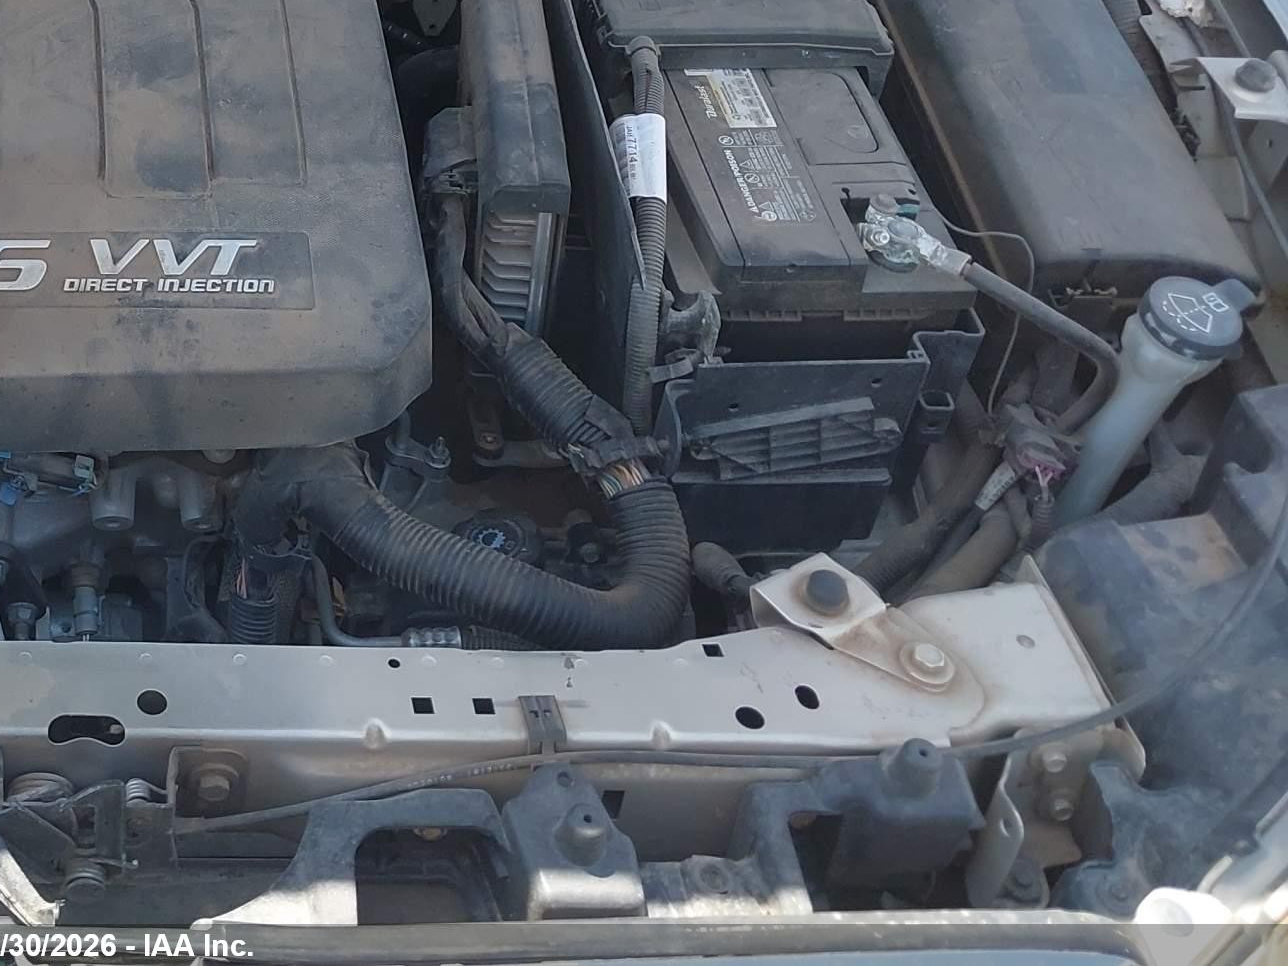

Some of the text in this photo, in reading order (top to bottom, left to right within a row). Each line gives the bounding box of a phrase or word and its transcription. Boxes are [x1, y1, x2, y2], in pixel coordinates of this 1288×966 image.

[694, 85, 717, 119] Duralast
[628, 137, 639, 163] 7714
[90, 239, 257, 276] VVT
[63, 278, 274, 293] DIRECT INJECTION
